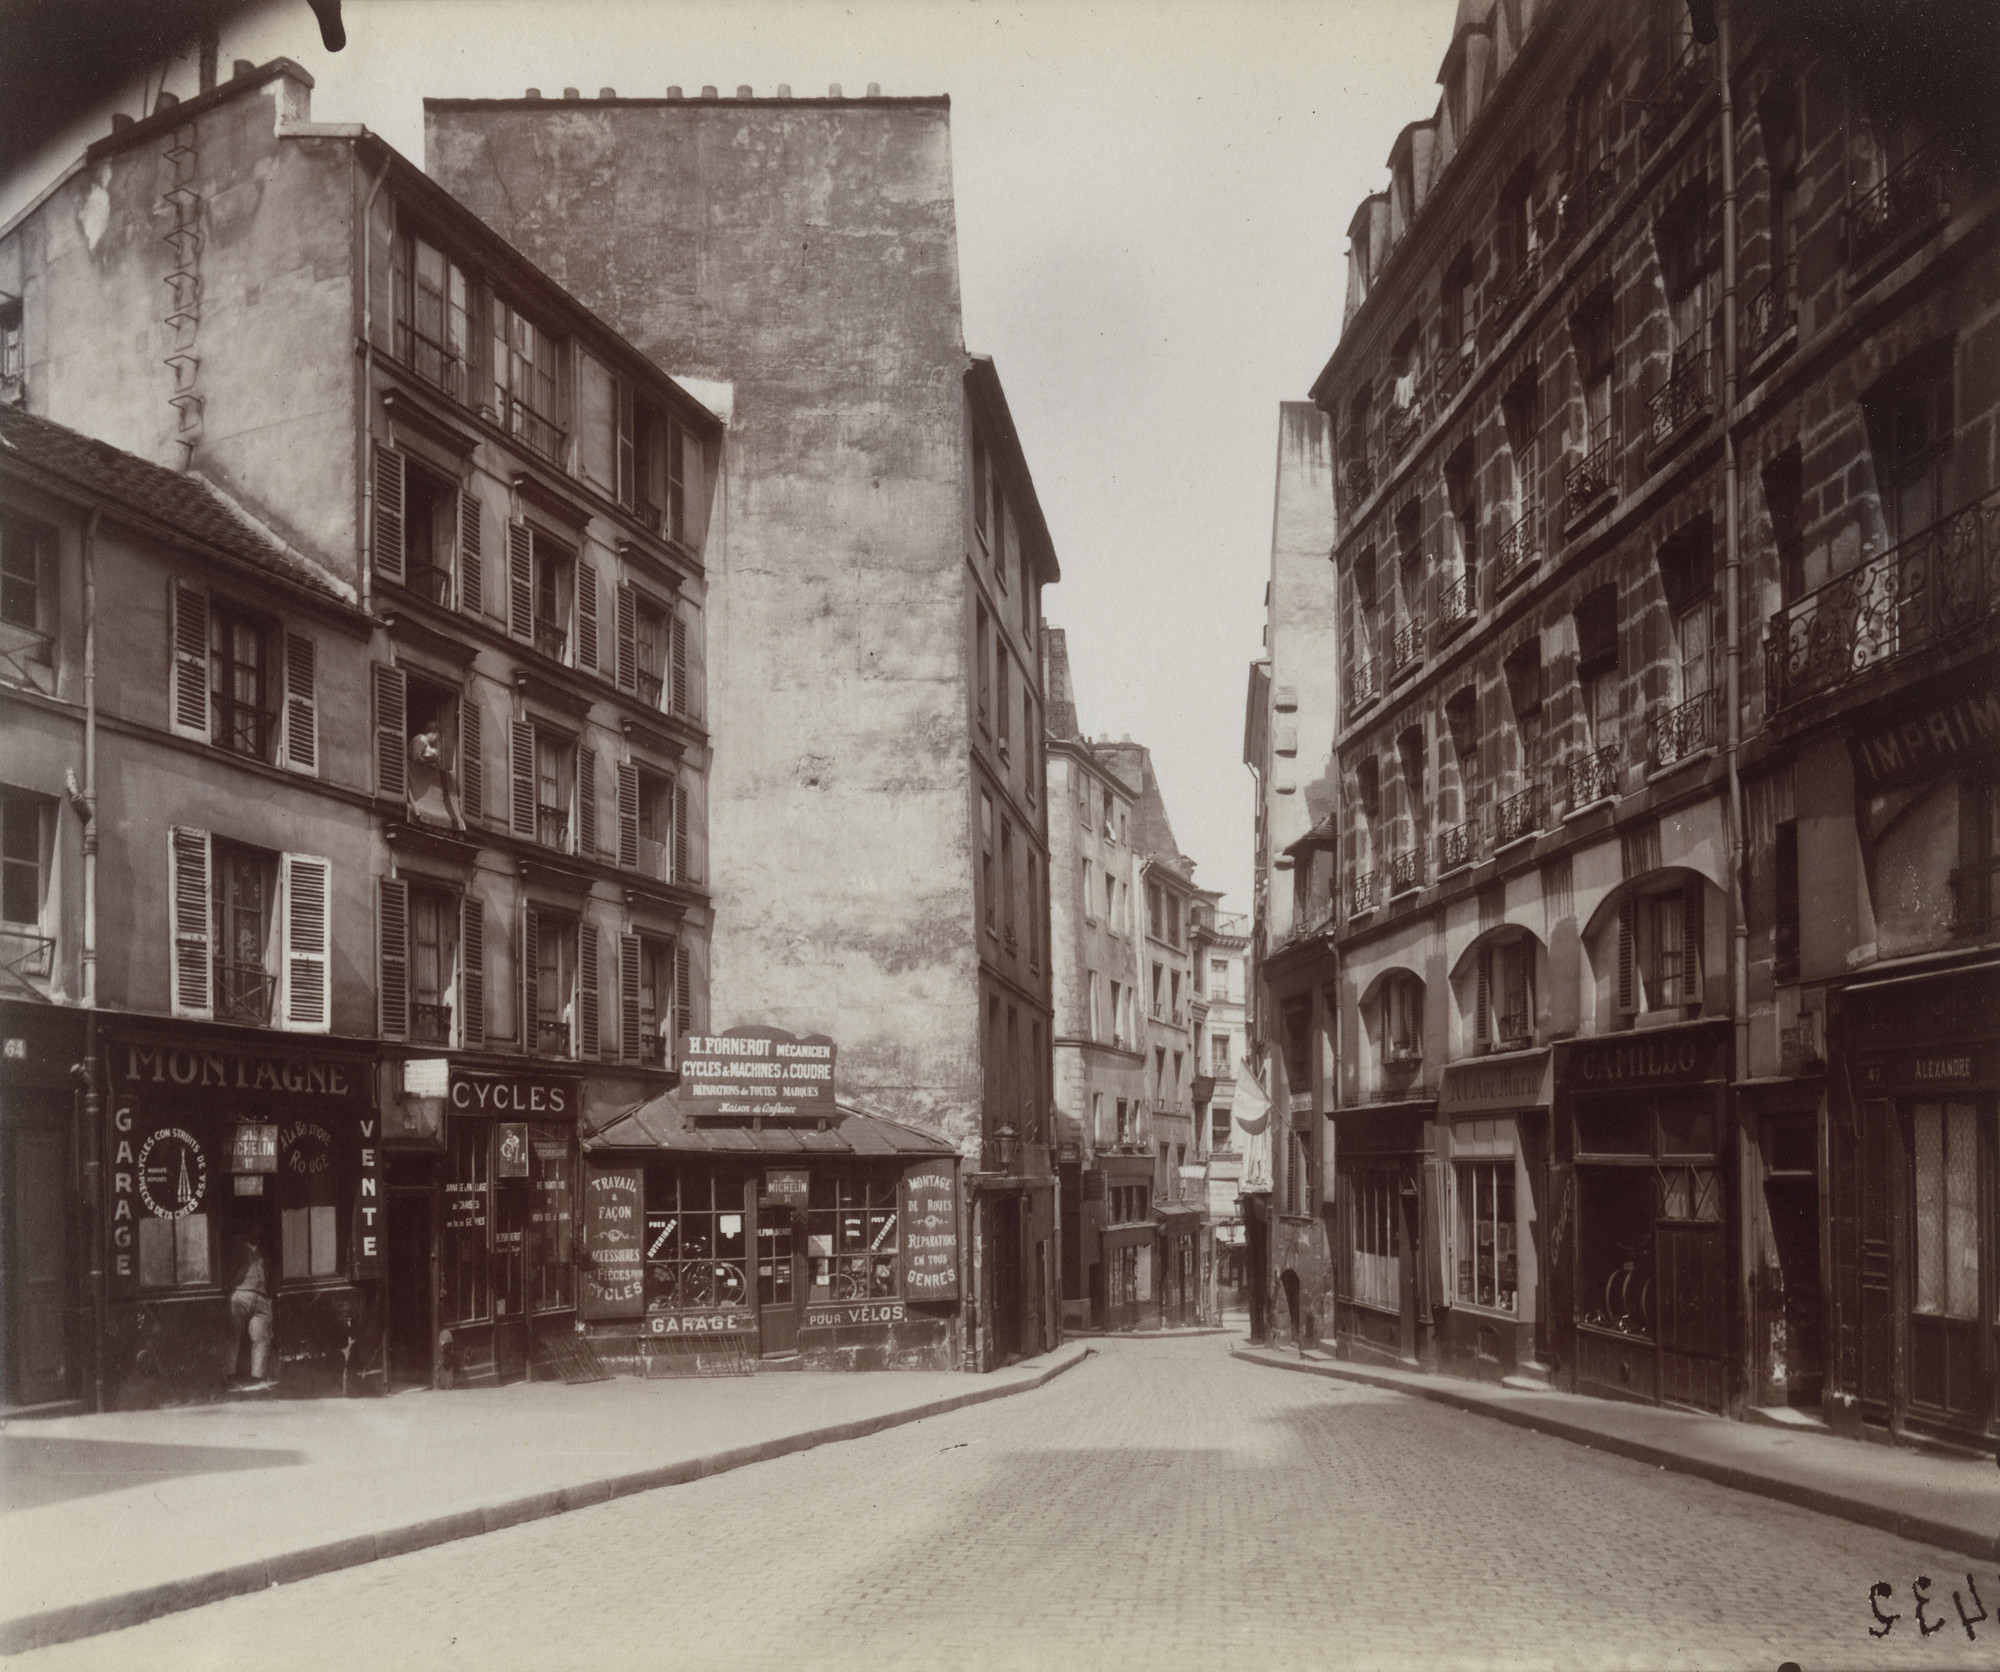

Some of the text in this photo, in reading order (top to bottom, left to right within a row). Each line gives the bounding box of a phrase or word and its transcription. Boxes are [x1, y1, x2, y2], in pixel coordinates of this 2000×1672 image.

[776, 1042, 830, 1058] MÉCANICIEN
[682, 1060, 721, 1078] CYCLES
[722, 1064, 730, 1077] &
[730, 1061, 782, 1079] MACHINES
[789, 1064, 832, 1080] COUDRE
[1583, 1040, 1696, 1081] CAMILLO
[1914, 1057, 1971, 1080] ALEXANDRE
[125, 1046, 349, 1096] MONTAGNE
[451, 1081, 566, 1112] CYCLES
[749, 1086, 777, 1096] TOUTES
[782, 1086, 819, 1098] MARQUES
[718, 1102, 750, 1113] Maison
[114, 1107, 134, 1276] GARAGE
[360, 1119, 377, 1257] VENTE
[591, 1176, 636, 1192] TRAVAIL
[768, 1182, 807, 1193] MICHELIN
[907, 1175, 953, 1192] MONTAGE
[598, 1205, 632, 1222] FAÇON
[908, 1199, 953, 1212] DE ROUES
[647, 1218, 678, 1258] HUTCHINSON
[870, 1214, 897, 1251] HUTCHINSON
[591, 1248, 640, 1262] ACCESSOIRES
[914, 1253, 948, 1266] EN TOUS
[906, 1267, 957, 1288] GENRES
[588, 1281, 643, 1301] CYCLES
[651, 1314, 738, 1333] GARAGE
[809, 1312, 841, 1326] POUR
